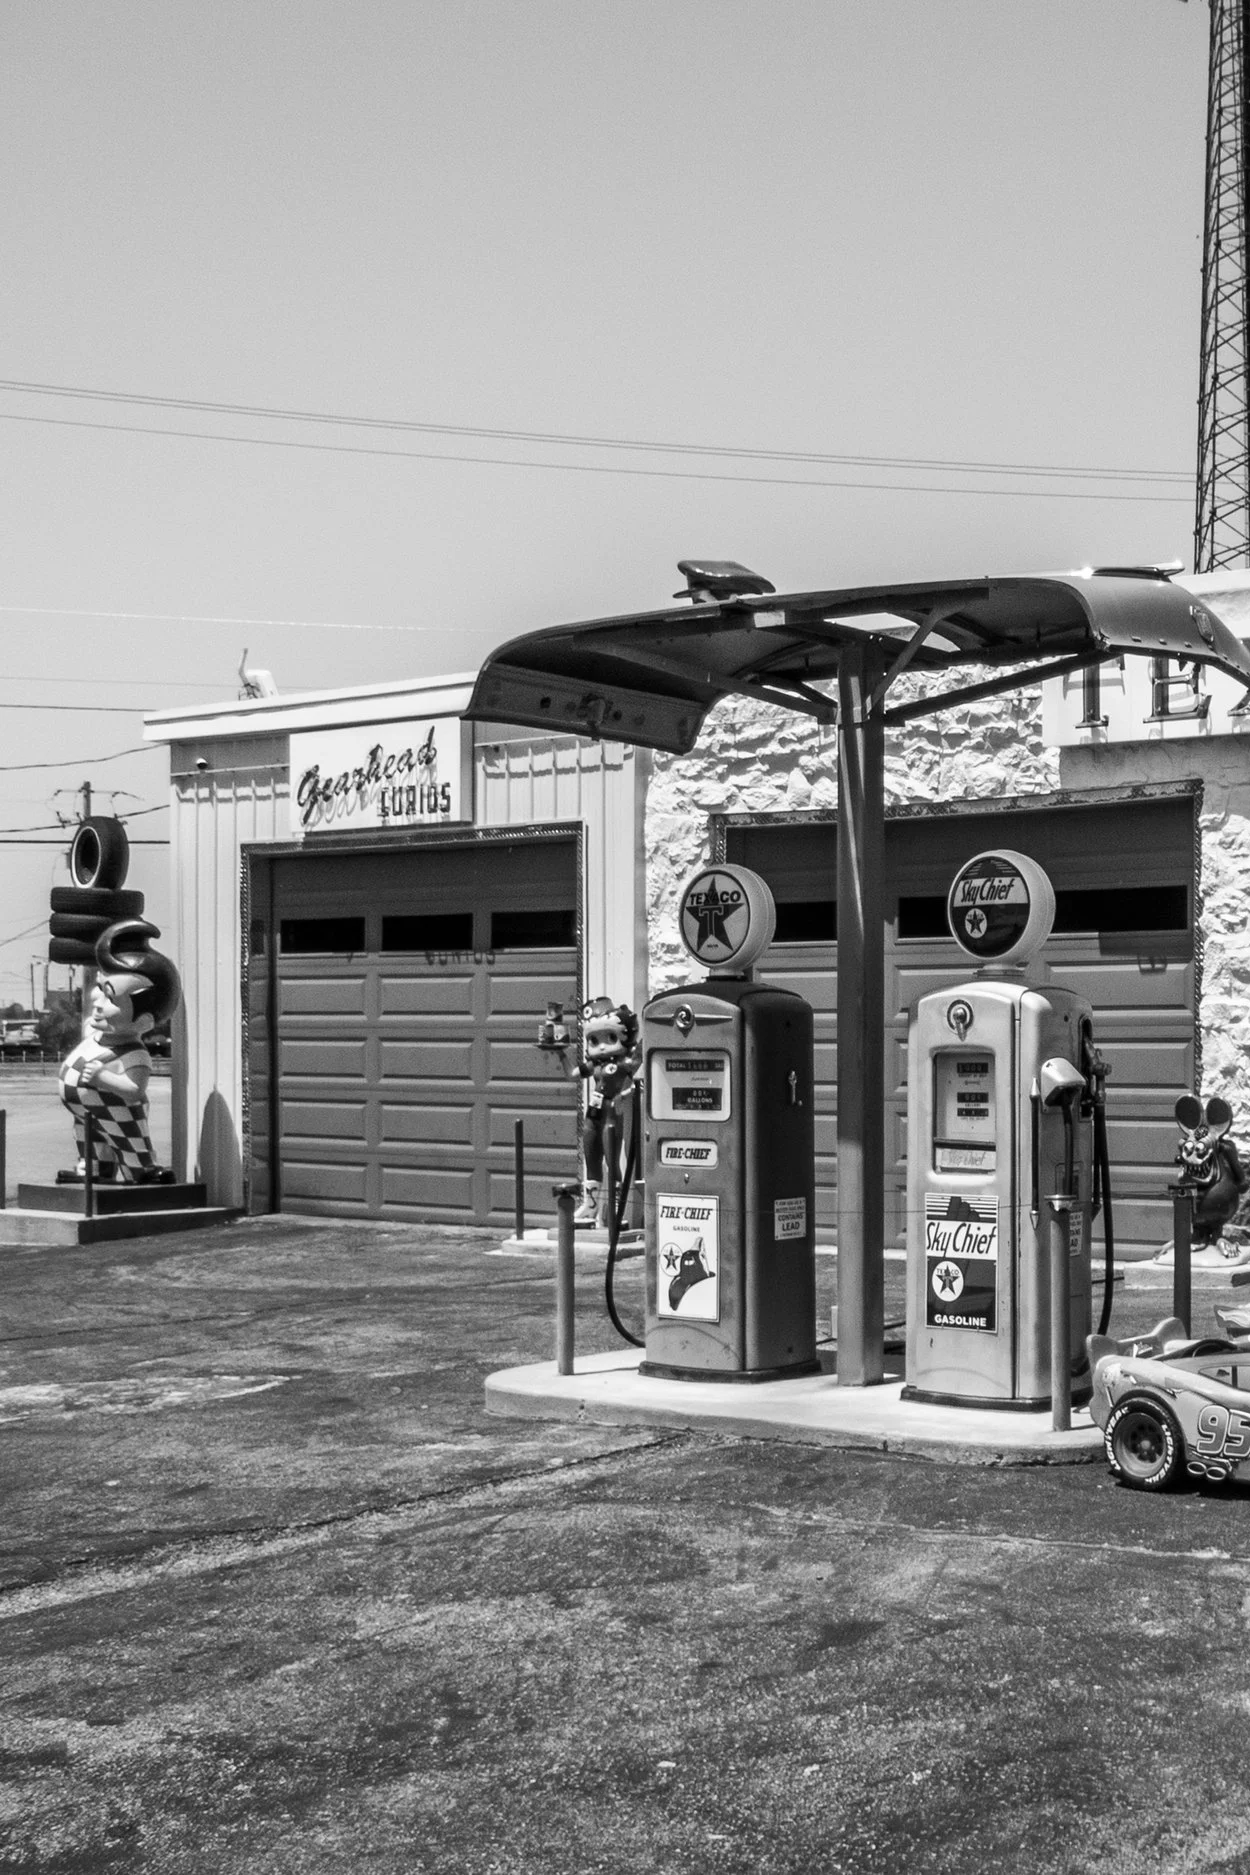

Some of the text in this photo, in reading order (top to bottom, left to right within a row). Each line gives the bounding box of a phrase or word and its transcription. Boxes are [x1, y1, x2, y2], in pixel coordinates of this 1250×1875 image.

[297, 725, 438, 825] Gearhead
[378, 782, 451, 818] CURIOS
[690, 890, 742, 906] TEXACO
[960, 877, 1015, 904] Sky Chief
[665, 1147, 712, 1160] FIRE-CHIEF
[660, 1205, 713, 1221] FIRE-CHIEF
[778, 1211, 804, 1222] CONTAINS
[782, 1221, 800, 1232] LEAD
[926, 1221, 997, 1258] Sky Chief
[934, 1314, 987, 1327] GASOLINE
